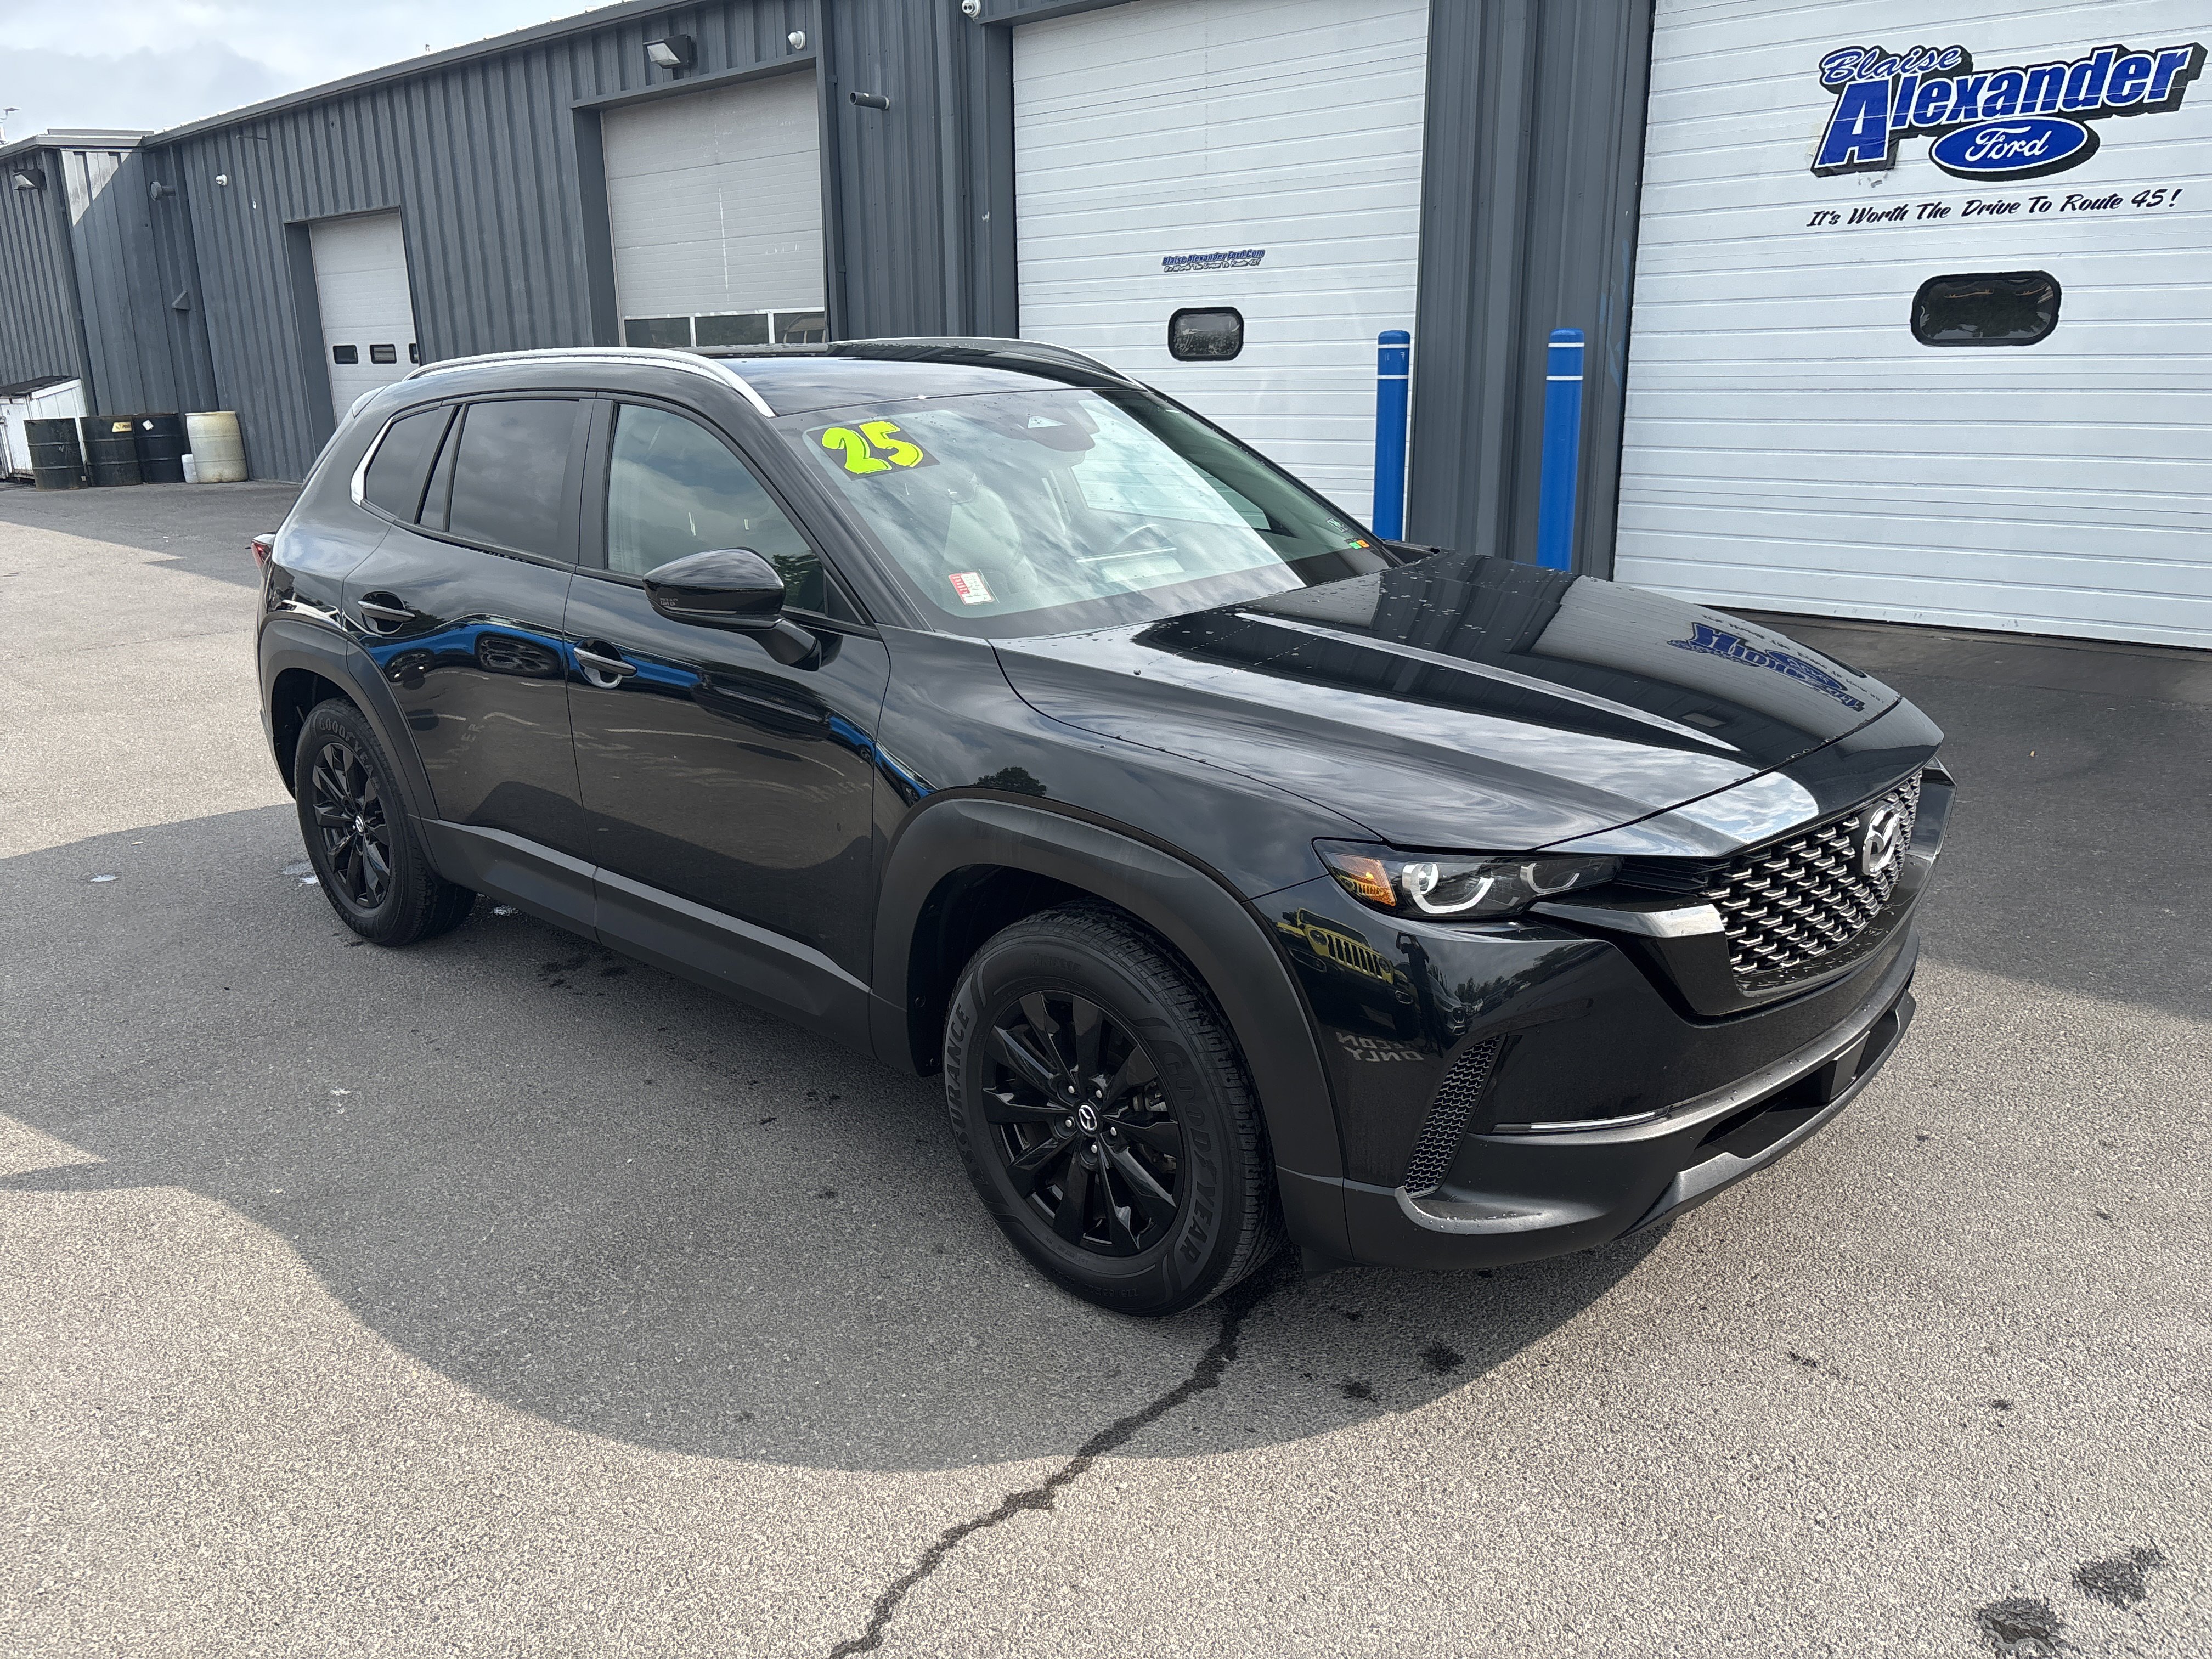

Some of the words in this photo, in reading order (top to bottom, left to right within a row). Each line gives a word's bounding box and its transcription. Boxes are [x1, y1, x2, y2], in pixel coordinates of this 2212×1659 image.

[1820, 44, 1965, 85] Blaise
[1812, 43, 2199, 172] Alexander
[1965, 124, 2052, 162] Ford
[1805, 210, 1842, 227] It's
[1846, 203, 1909, 225] Worth
[1916, 201, 1952, 221] The
[1960, 199, 2021, 217] Drive
[2028, 195, 2053, 213] To
[2059, 193, 2124, 212] Route
[822, 421, 923, 474] 25
[319, 718, 381, 790] GOODYEAR
[946, 1002, 989, 1186] ASSURANCE
[1162, 1051, 1218, 1267] GOODYEAR
